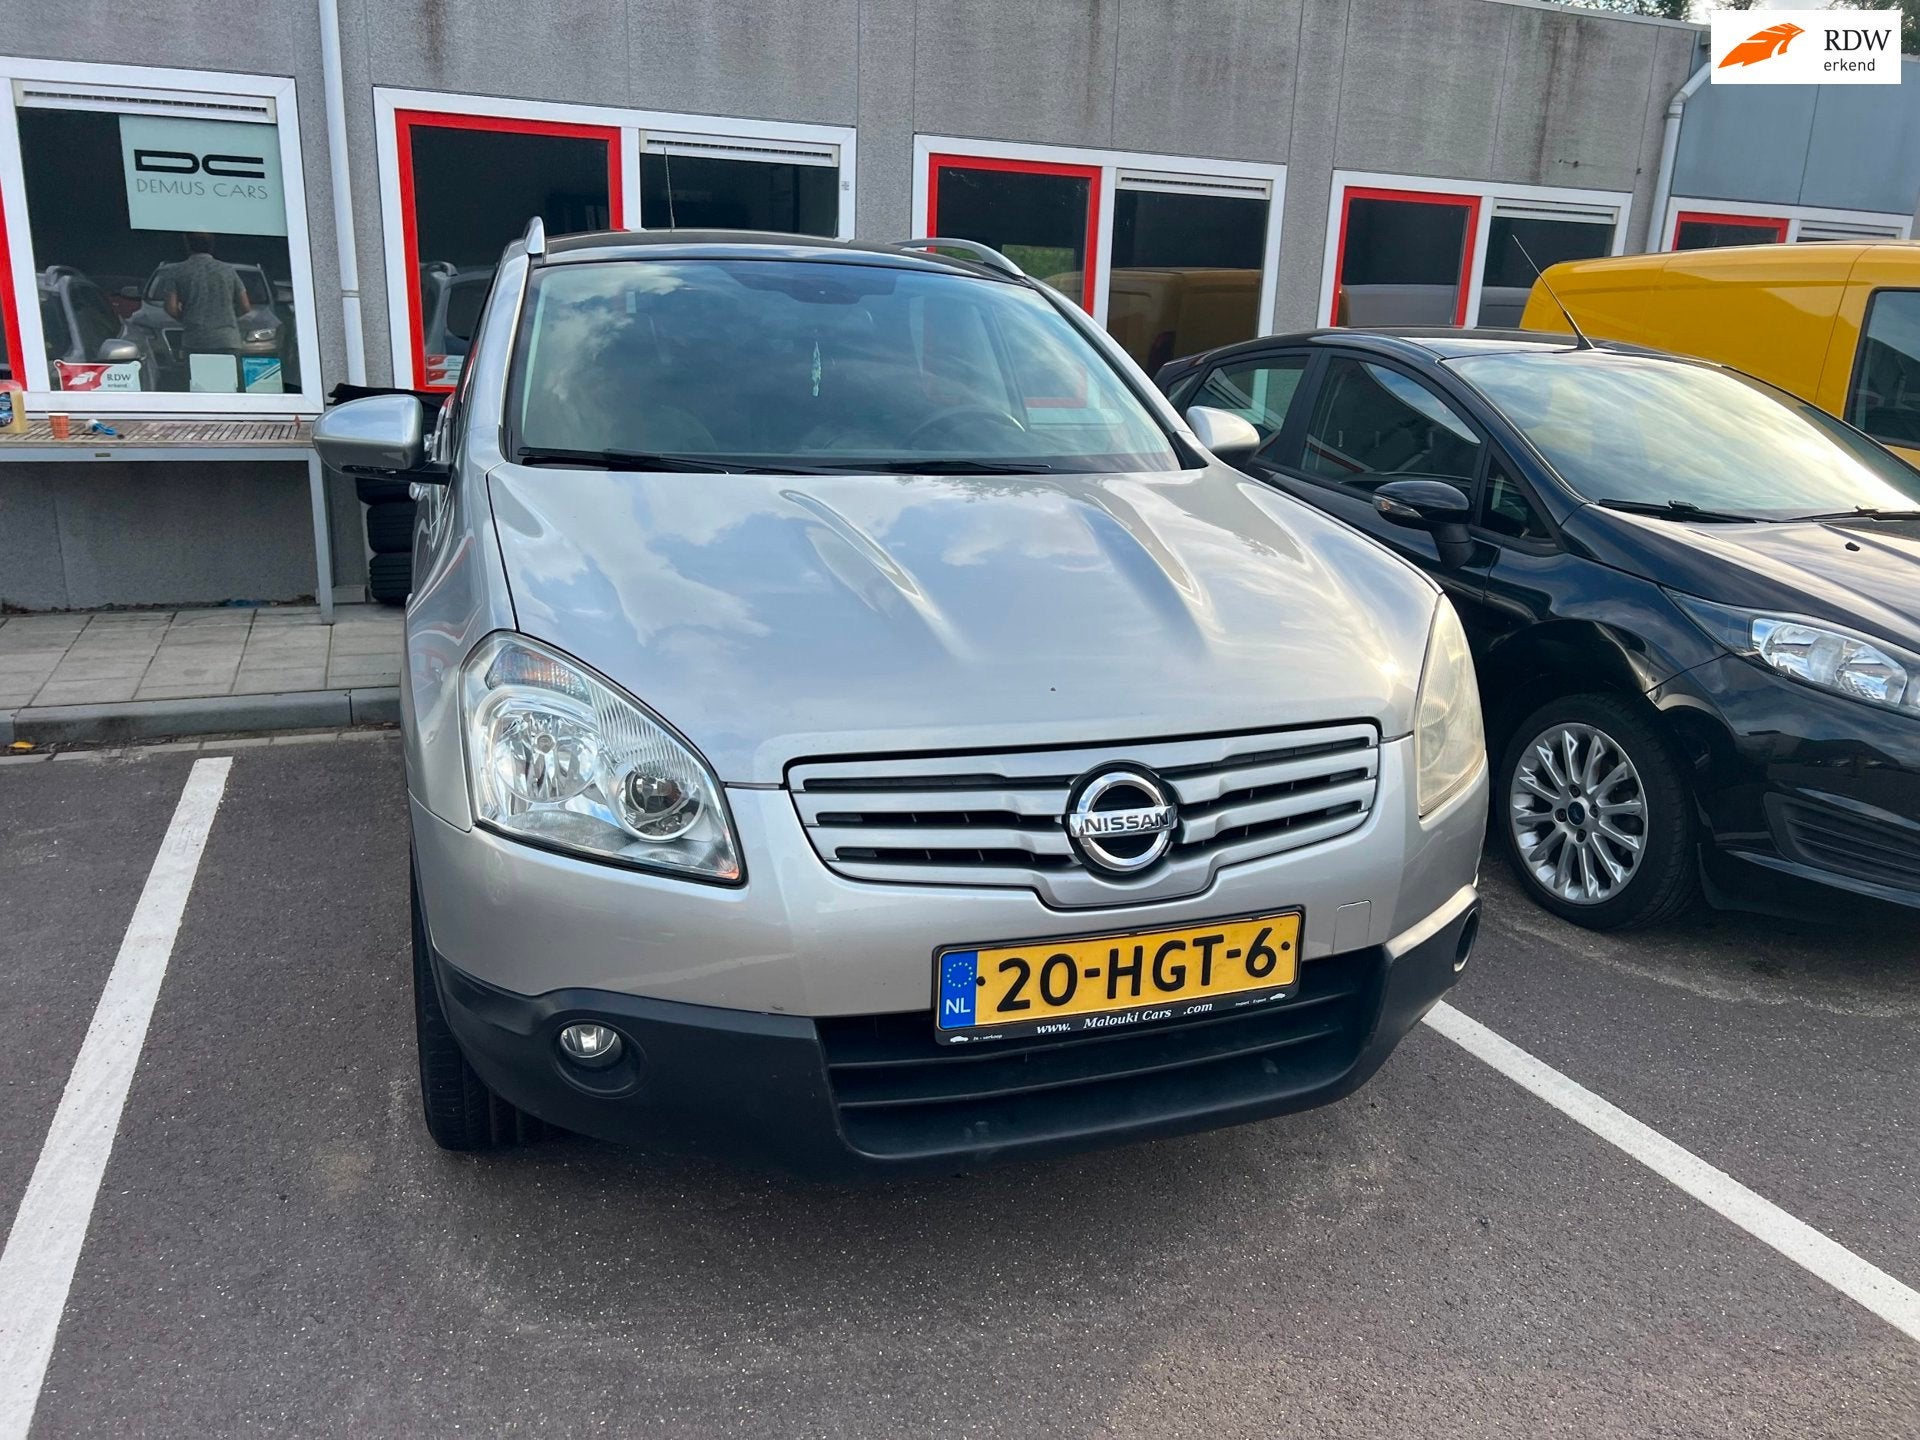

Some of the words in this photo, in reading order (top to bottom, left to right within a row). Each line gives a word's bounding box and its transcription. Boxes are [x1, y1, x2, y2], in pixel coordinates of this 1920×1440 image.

[134, 149, 265, 179] DC
[136, 178, 205, 196] DEMUS
[213, 183, 268, 200] CARS
[106, 373, 132, 381] RDW
[1084, 811, 1170, 834] NISSAN
[996, 927, 1278, 1013] 20-HGT-6
[945, 998, 971, 1015] NL
[1036, 1022, 1071, 1034] www.
[1083, 1011, 1139, 1029] Malouki
[1142, 1009, 1172, 1021] Cars
[1183, 1003, 1213, 1015] .com
